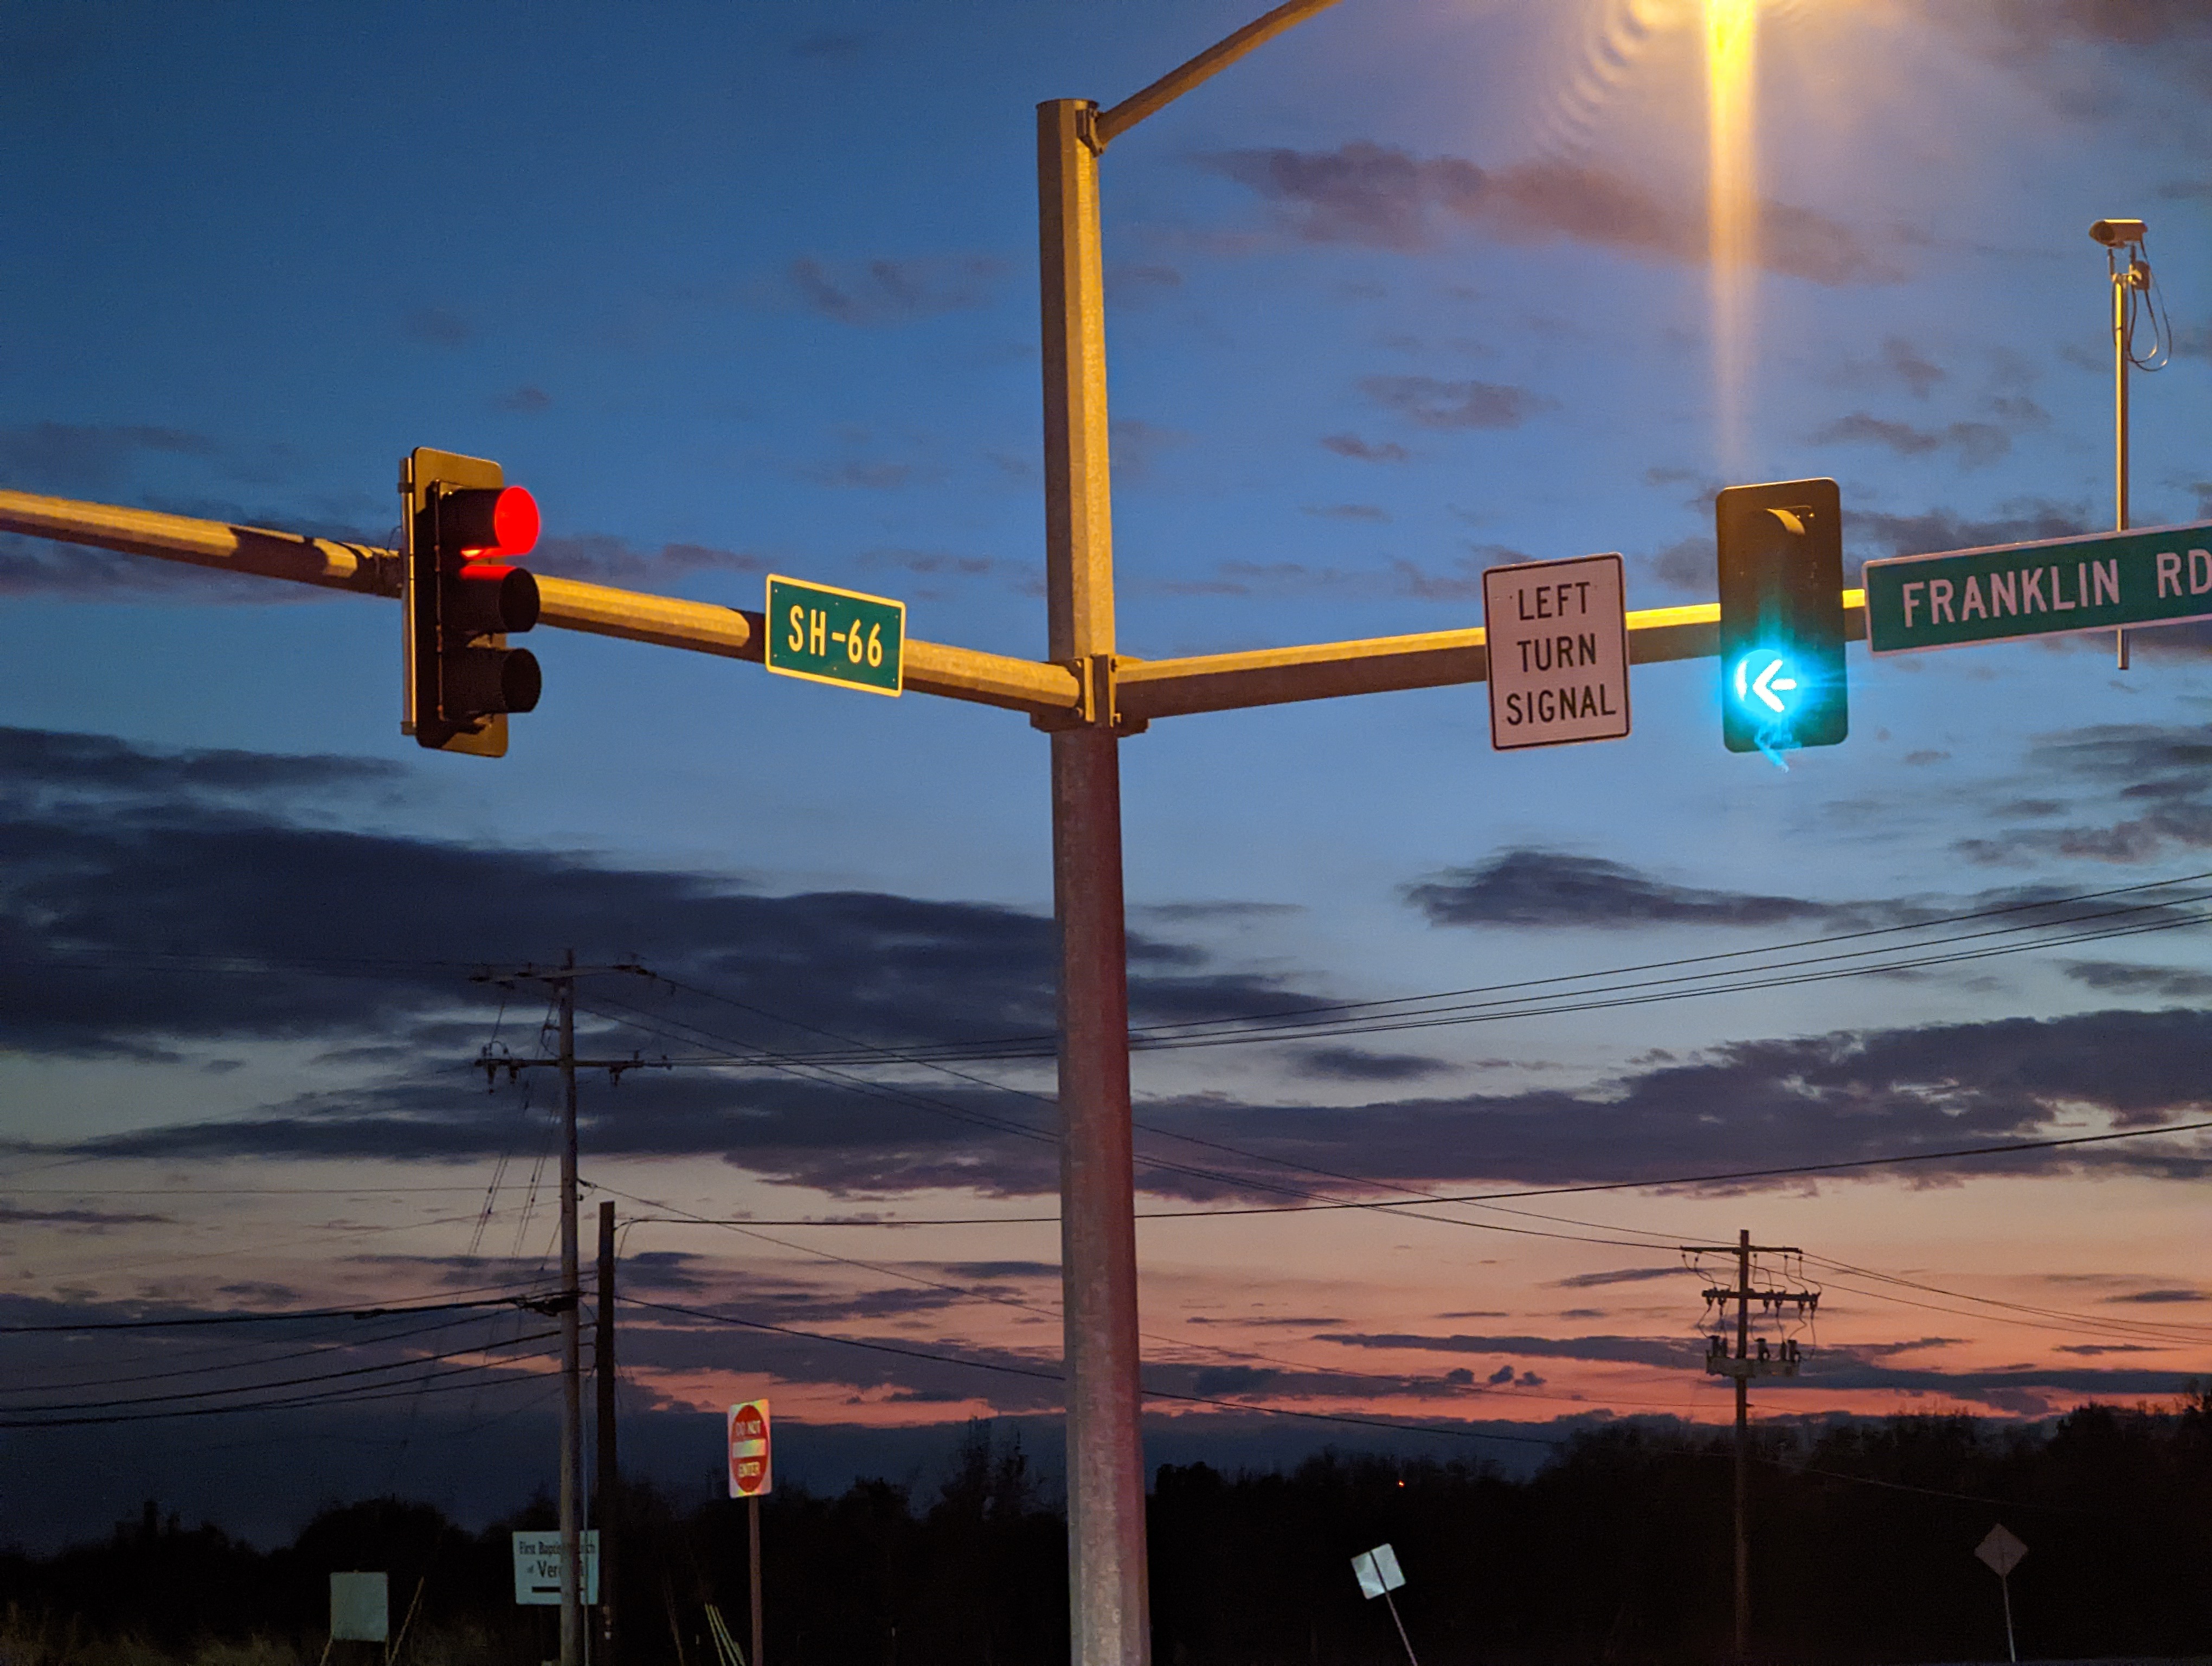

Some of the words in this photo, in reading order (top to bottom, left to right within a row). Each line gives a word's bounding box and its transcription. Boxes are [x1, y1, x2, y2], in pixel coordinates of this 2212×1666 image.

[1518, 582, 1591, 620] LEFT
[1902, 559, 2120, 627] FRANKLIN
[2156, 549, 2212, 598] RD
[788, 605, 883, 667] SH-66
[1517, 633, 1596, 672] TURN
[1506, 683, 1616, 726] SIGNAL
[747, 1420, 761, 1434] NOT
[738, 1461, 761, 1477] ENTER
[519, 1541, 535, 1555] First
